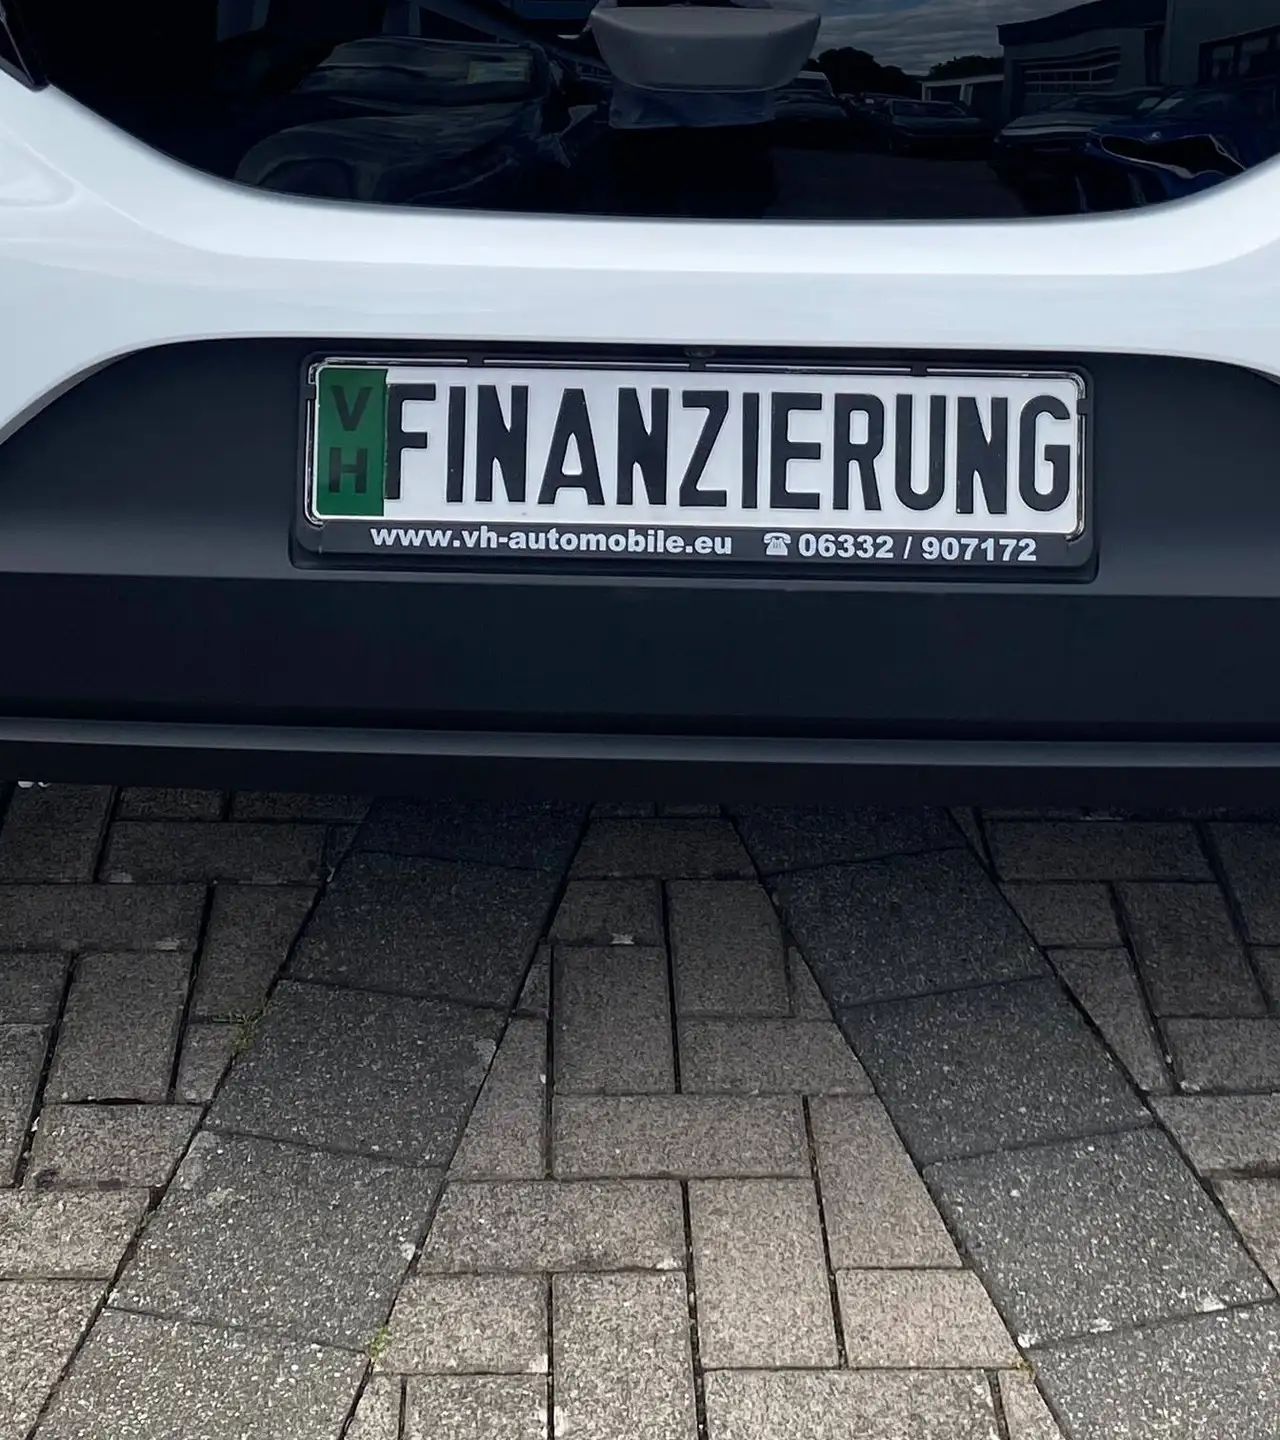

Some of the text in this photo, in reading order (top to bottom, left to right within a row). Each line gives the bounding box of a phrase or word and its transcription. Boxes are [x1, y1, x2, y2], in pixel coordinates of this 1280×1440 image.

[385, 383, 1072, 514] FINANZIERUNG
[370, 525, 1037, 561] www.vh-automobile.eu 06332 / 907172
